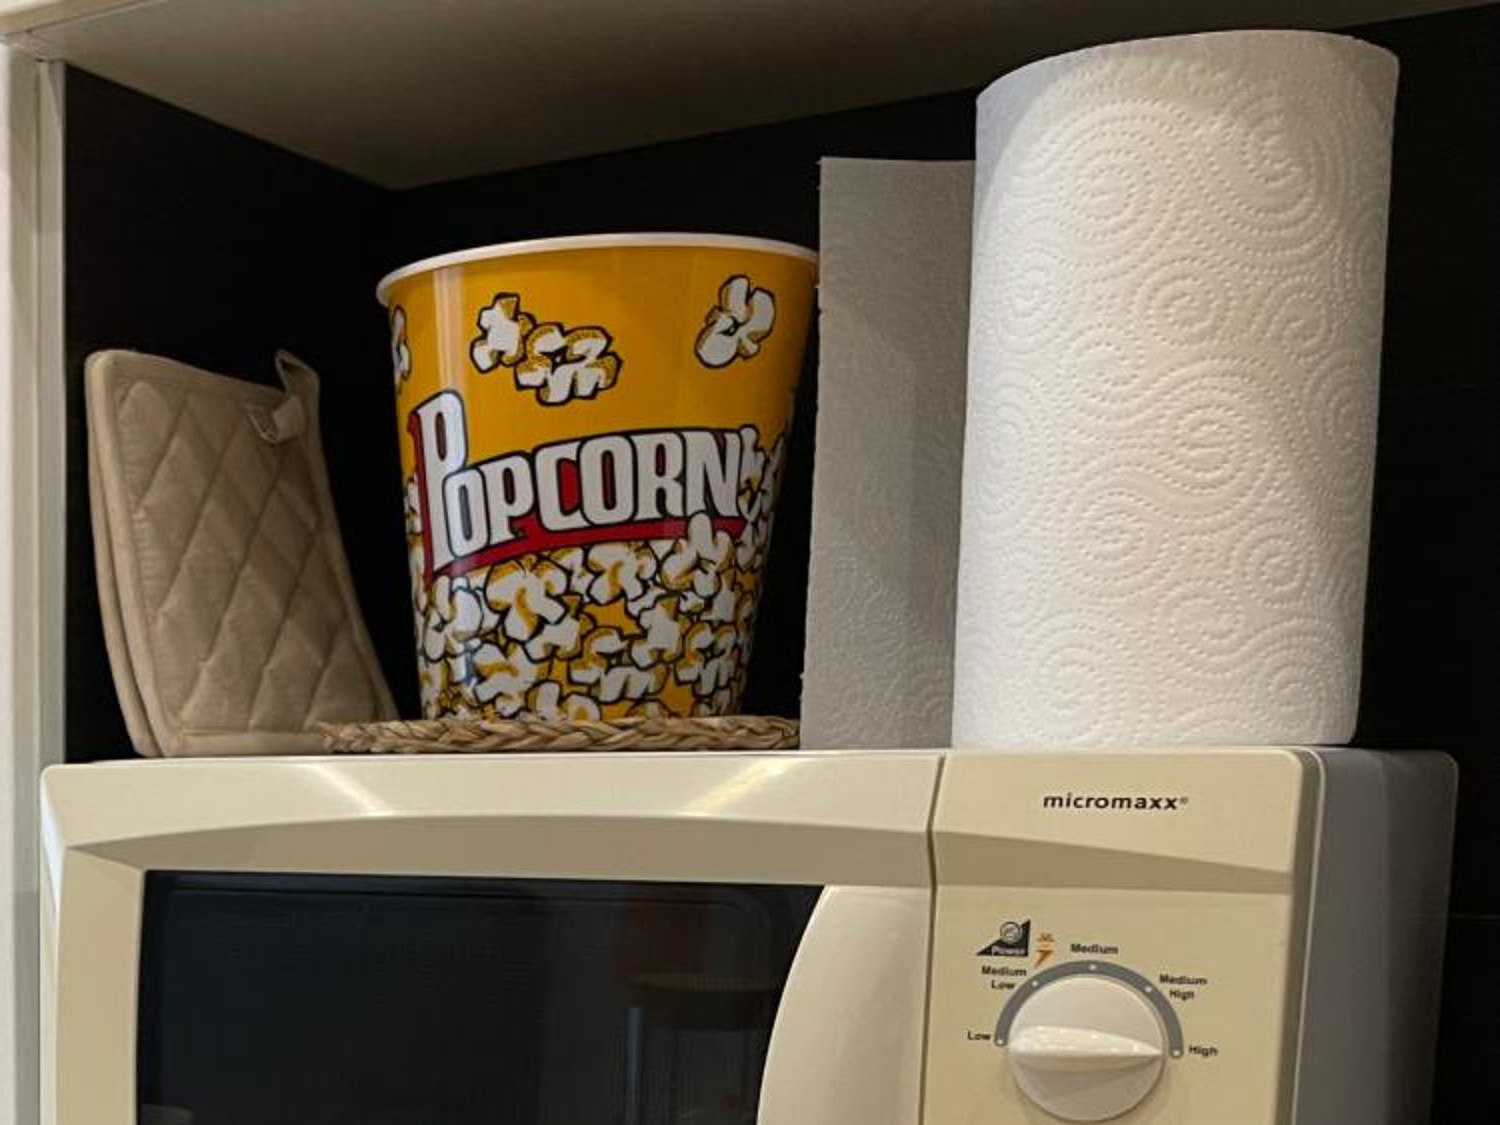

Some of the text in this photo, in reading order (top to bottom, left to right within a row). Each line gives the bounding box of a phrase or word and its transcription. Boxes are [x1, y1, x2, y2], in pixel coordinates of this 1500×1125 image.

[412, 389, 744, 572] POPCORN
[1070, 942, 1120, 955] Medium
[981, 965, 1027, 977] Medium
[991, 979, 1015, 989] Low
[1158, 973, 1208, 986] Medium
[1169, 989, 1196, 1001] High
[967, 1030, 991, 1041] Low
[1188, 1045, 1219, 1059] High
